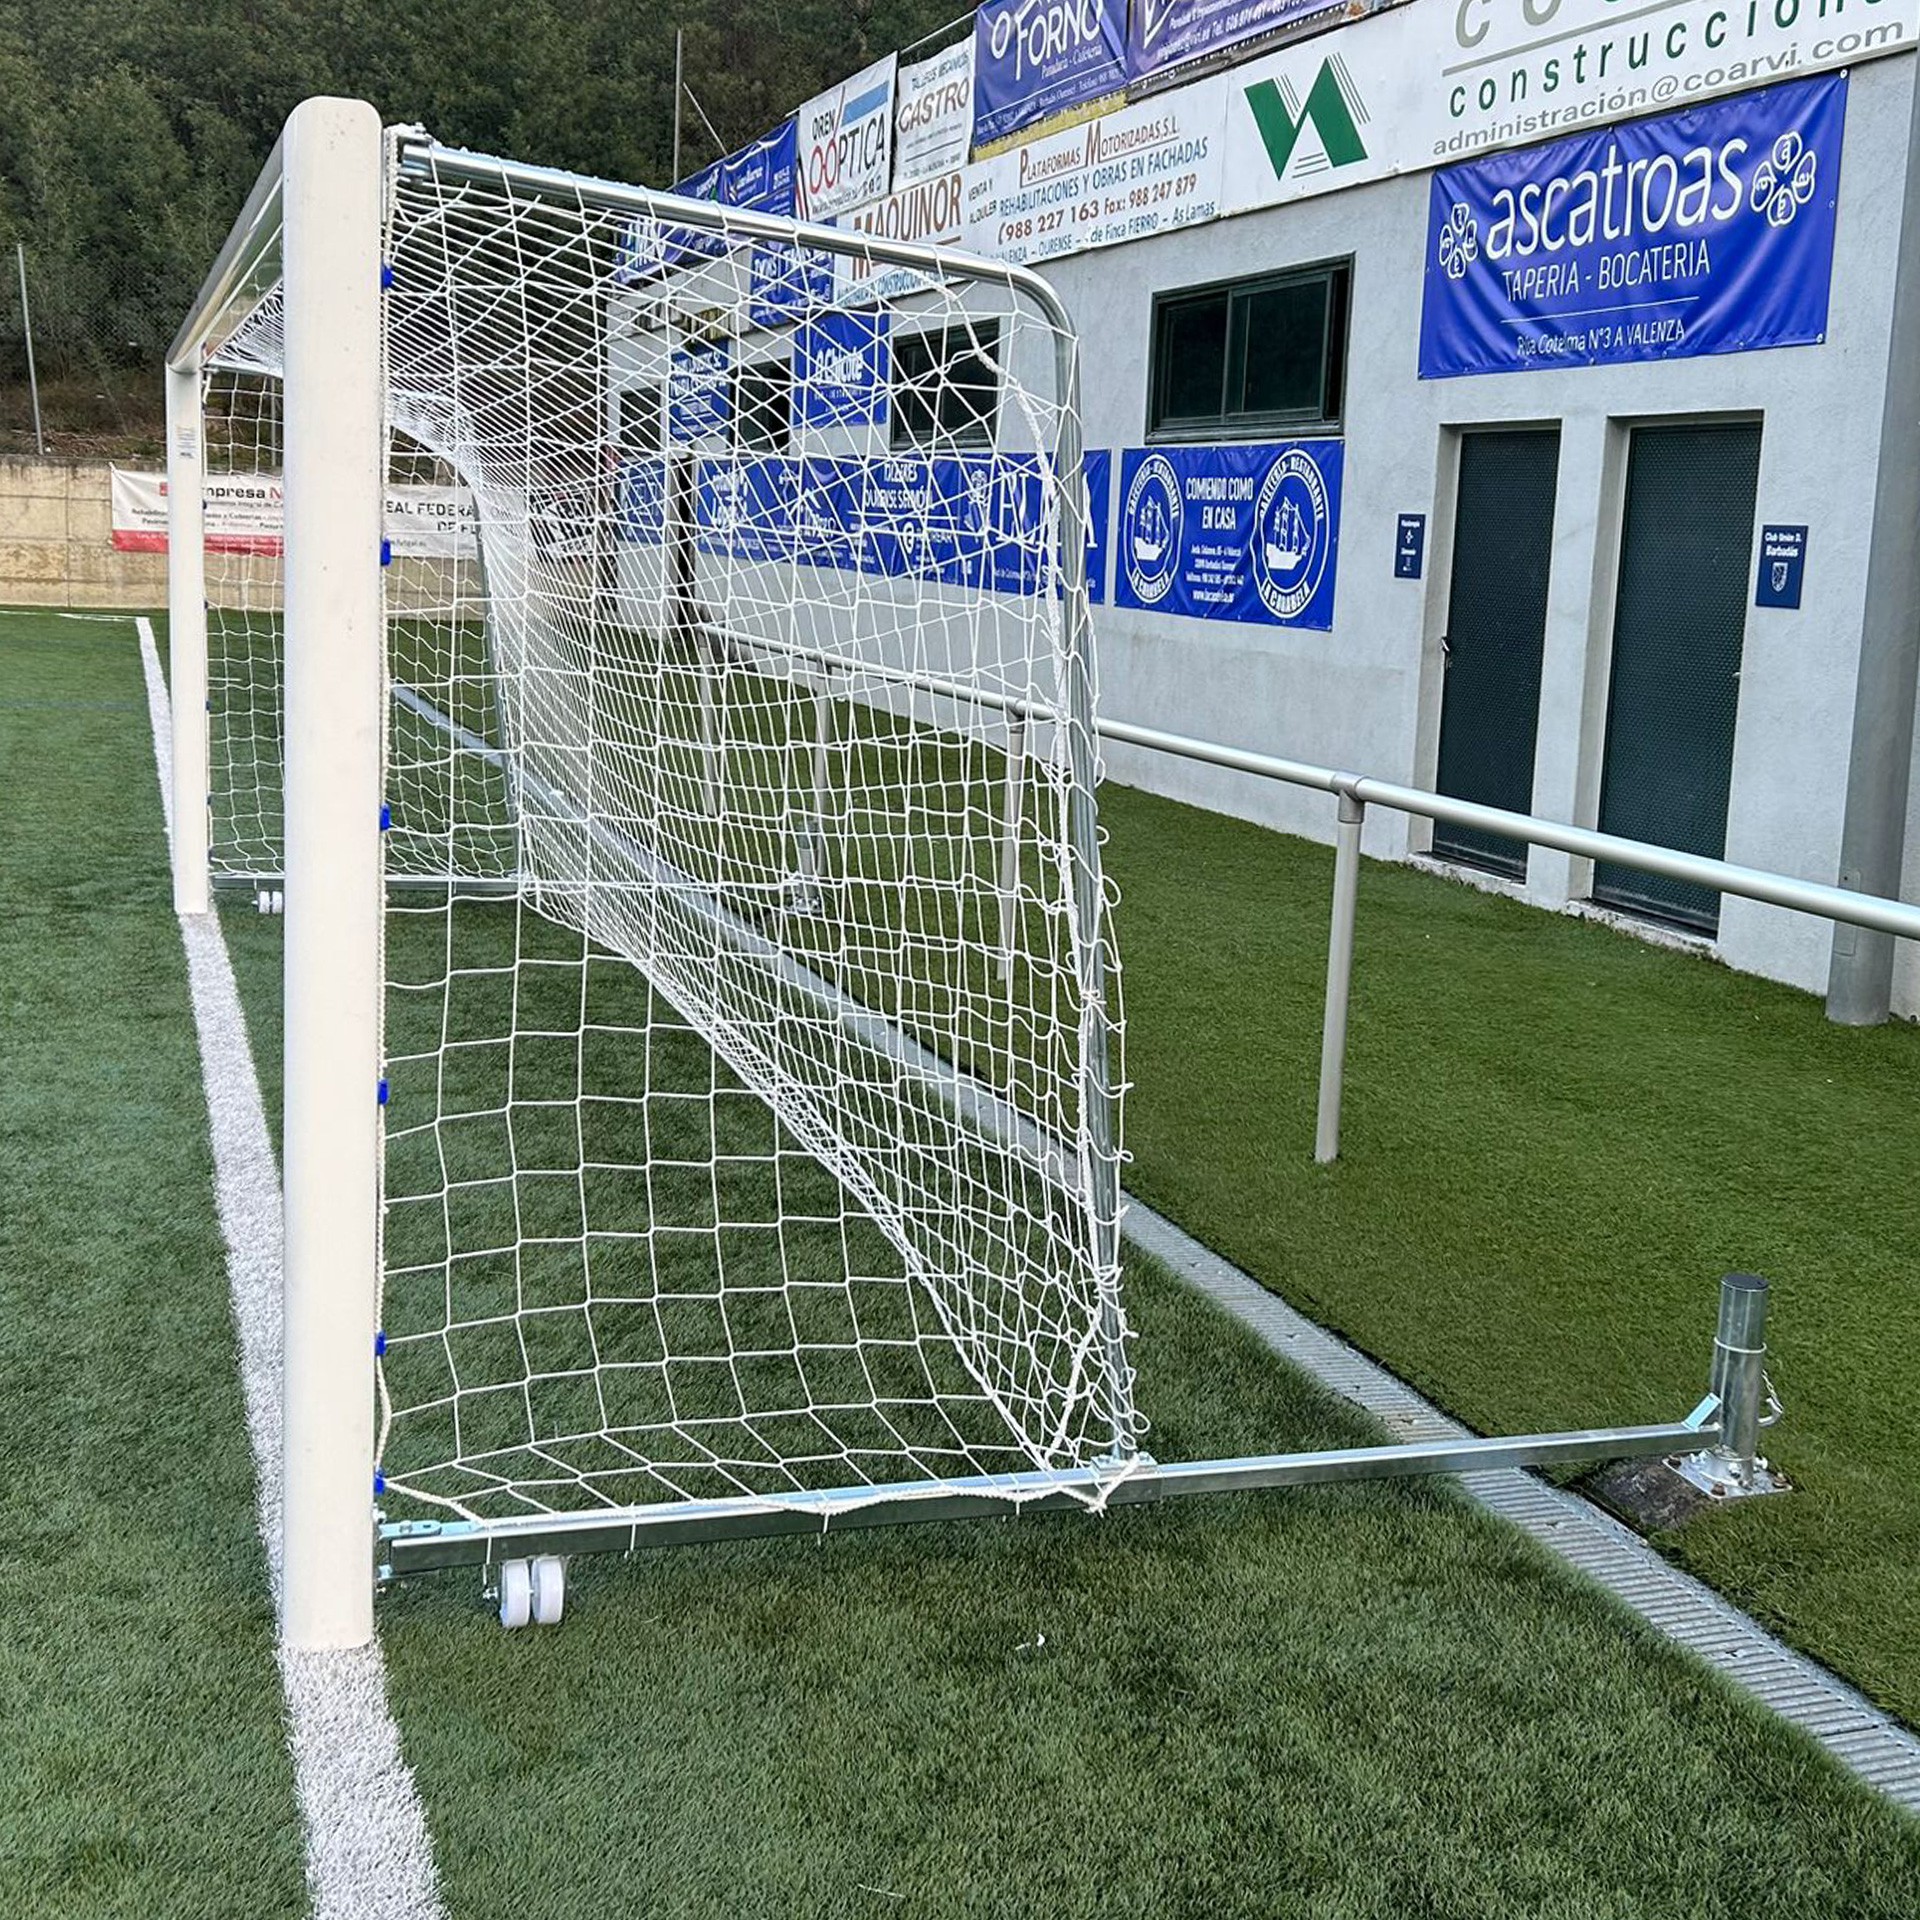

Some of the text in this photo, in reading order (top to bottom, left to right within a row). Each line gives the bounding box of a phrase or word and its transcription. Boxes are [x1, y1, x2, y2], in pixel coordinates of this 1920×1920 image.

[1450, 0, 1889, 118] construccio
[812, 108, 834, 141] OREN
[899, 77, 969, 133] CASTRO
[1000, 136, 1208, 218] REHABILITACIONES Y OBRAS EN FACHADAS
[1020, 148, 1082, 188] PLATAFORMAS
[1038, 209, 1065, 234] 227
[1071, 200, 1100, 222] 163
[1129, 189, 1150, 209] 988
[1152, 180, 1172, 204] 247
[1175, 172, 1198, 197] 879
[1485, 138, 1747, 261] ascatroas
[1038, 234, 1072, 258] OURENSE
[1128, 212, 1158, 235] FIERRO
[1172, 207, 1186, 225] As
[1186, 201, 1215, 220] Lamas
[1502, 239, 1712, 303] TAPERIA BOCATERIA
[1626, 319, 1686, 346] VALENZA
[202, 486, 266, 499] mpresa
[385, 501, 413, 514] EAL
[1228, 476, 1254, 501] COMO
[1202, 505, 1236, 531] EN CASA
